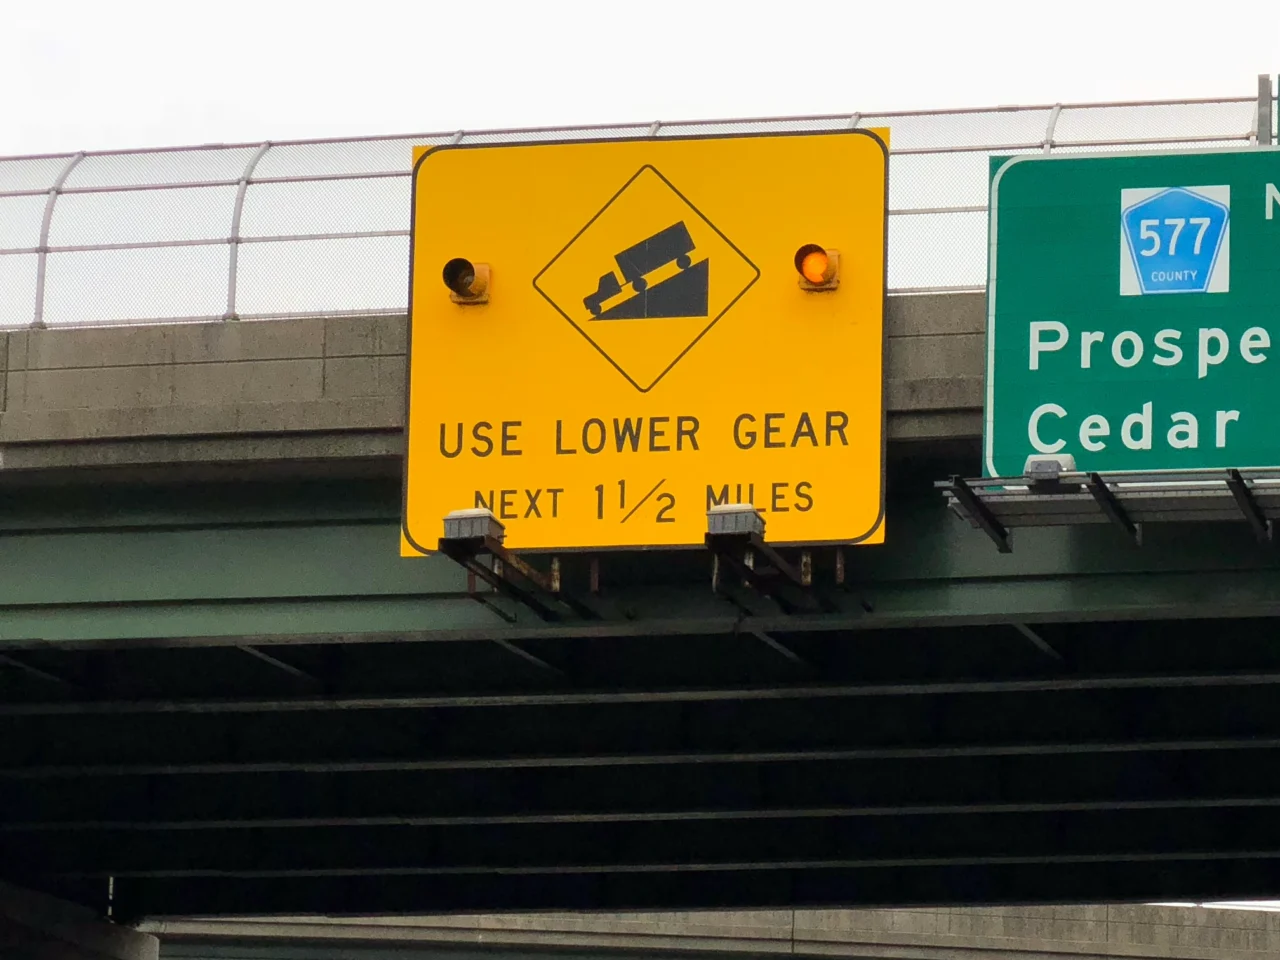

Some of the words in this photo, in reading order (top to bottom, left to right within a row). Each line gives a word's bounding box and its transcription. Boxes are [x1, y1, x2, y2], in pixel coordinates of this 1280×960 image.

[1140, 217, 1211, 257] 577
[1151, 269, 1198, 282] COUNTY
[439, 420, 523, 459] USE
[555, 415, 700, 456] LOWER
[733, 410, 850, 450] GEAR
[1028, 401, 1240, 454] Cedar
[474, 488, 564, 520] NEXT
[706, 481, 814, 513] MILES
